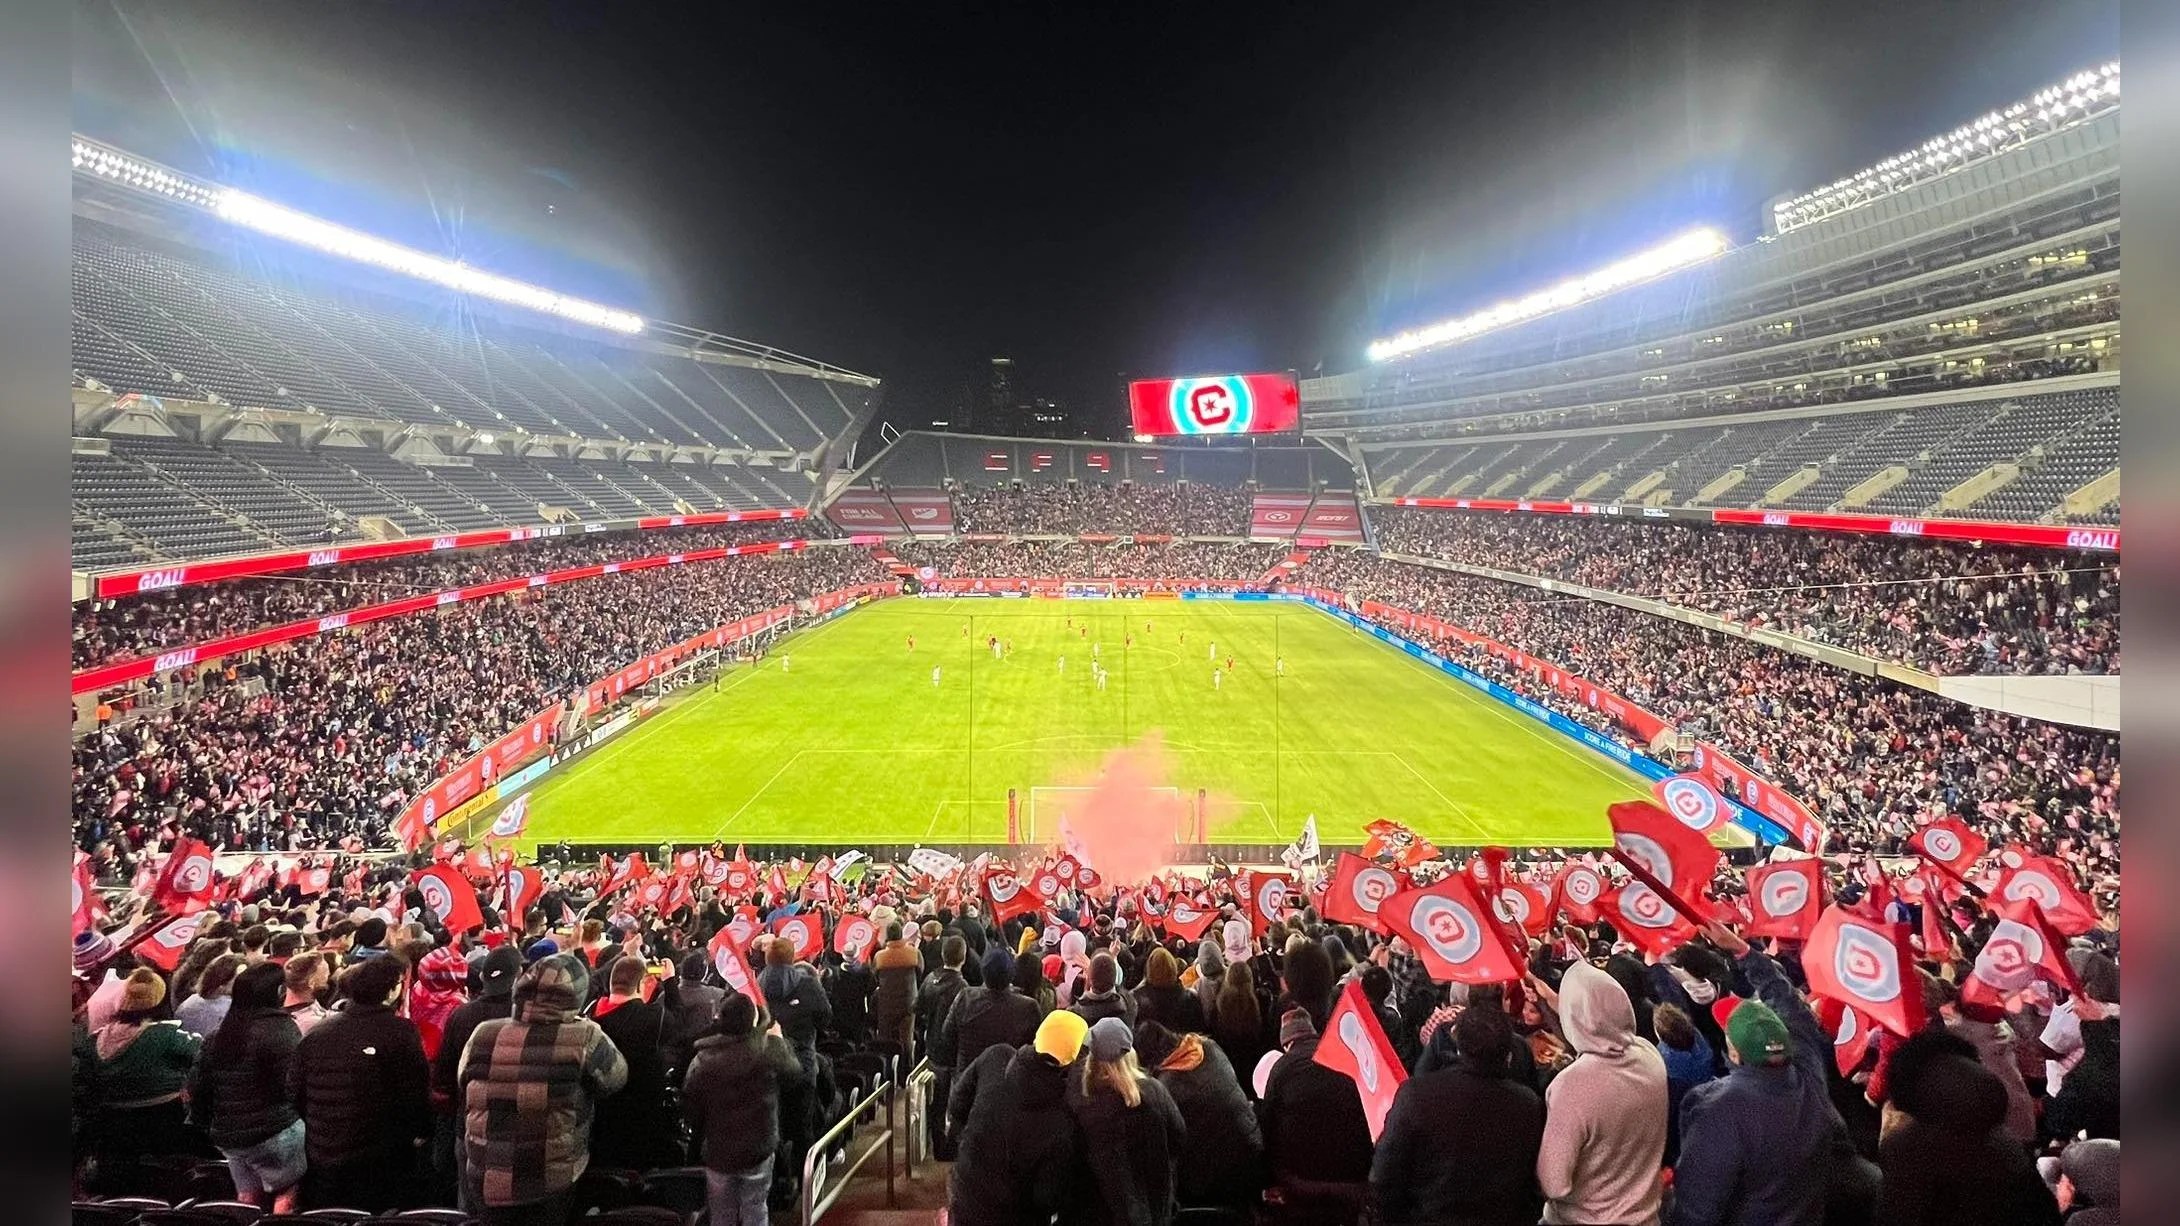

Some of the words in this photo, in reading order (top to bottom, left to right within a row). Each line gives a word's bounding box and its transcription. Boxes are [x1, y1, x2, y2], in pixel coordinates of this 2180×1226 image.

[1890, 521, 1924, 535] GOAL!
[2067, 530, 2118, 549] GOAL!
[309, 552, 340, 567] GOAL!
[139, 569, 185, 591] GOAL!
[319, 614, 349, 631] GOAL!
[154, 649, 197, 672] GOAL!
